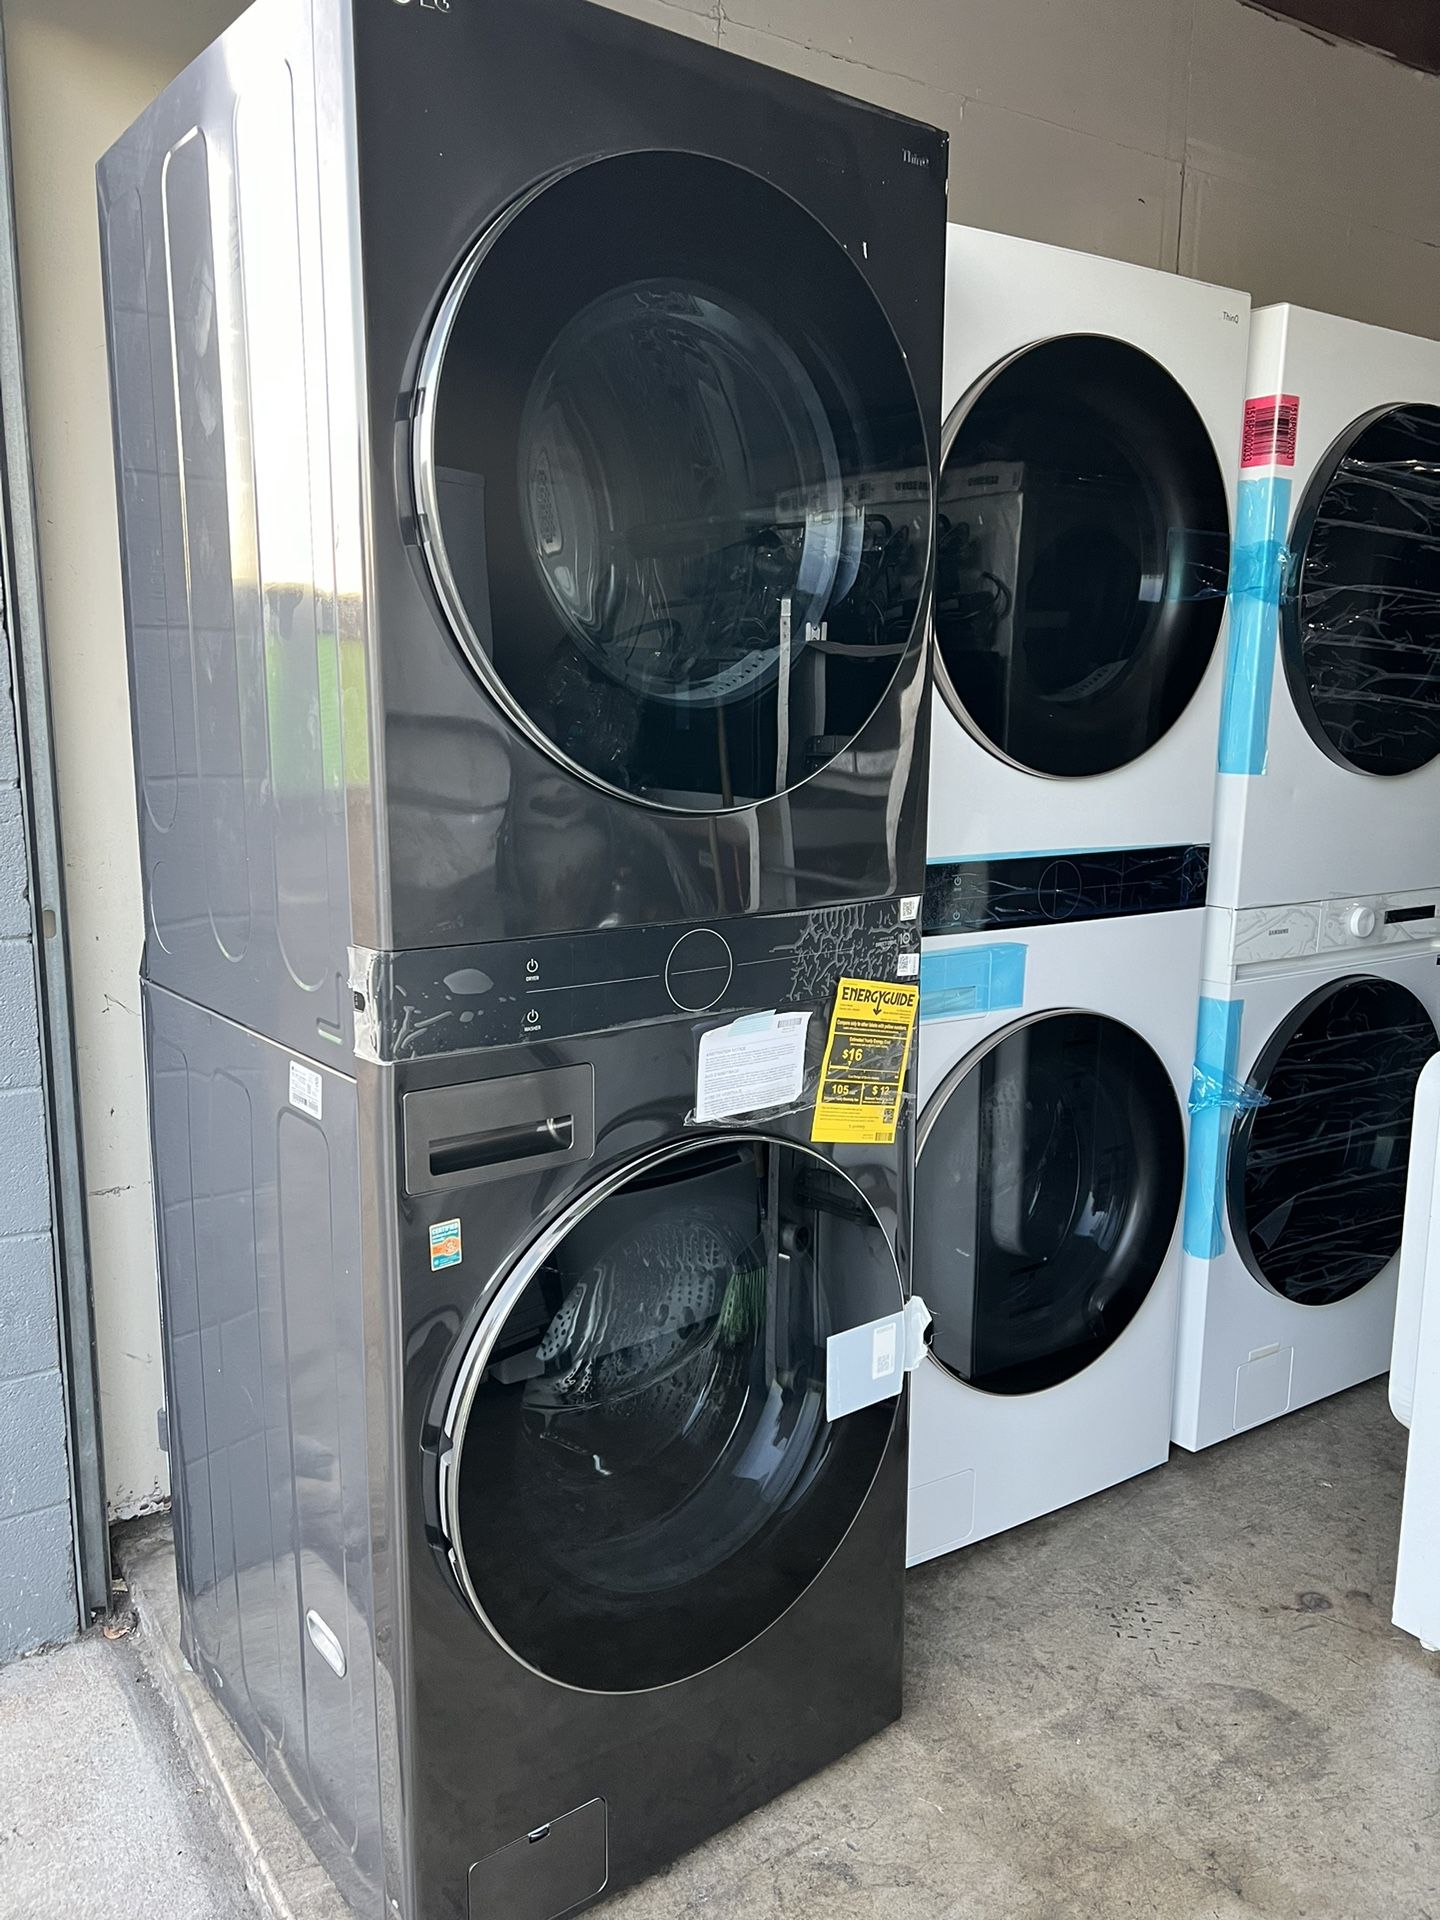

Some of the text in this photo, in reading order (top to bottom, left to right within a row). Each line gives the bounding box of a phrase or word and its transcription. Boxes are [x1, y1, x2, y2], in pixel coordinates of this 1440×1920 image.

[1223, 311, 1239, 324] ThinQ
[842, 986, 915, 1007] ENERGYGUIDE
[842, 1047, 863, 1062] $16
[832, 1084, 849, 1095] 105
